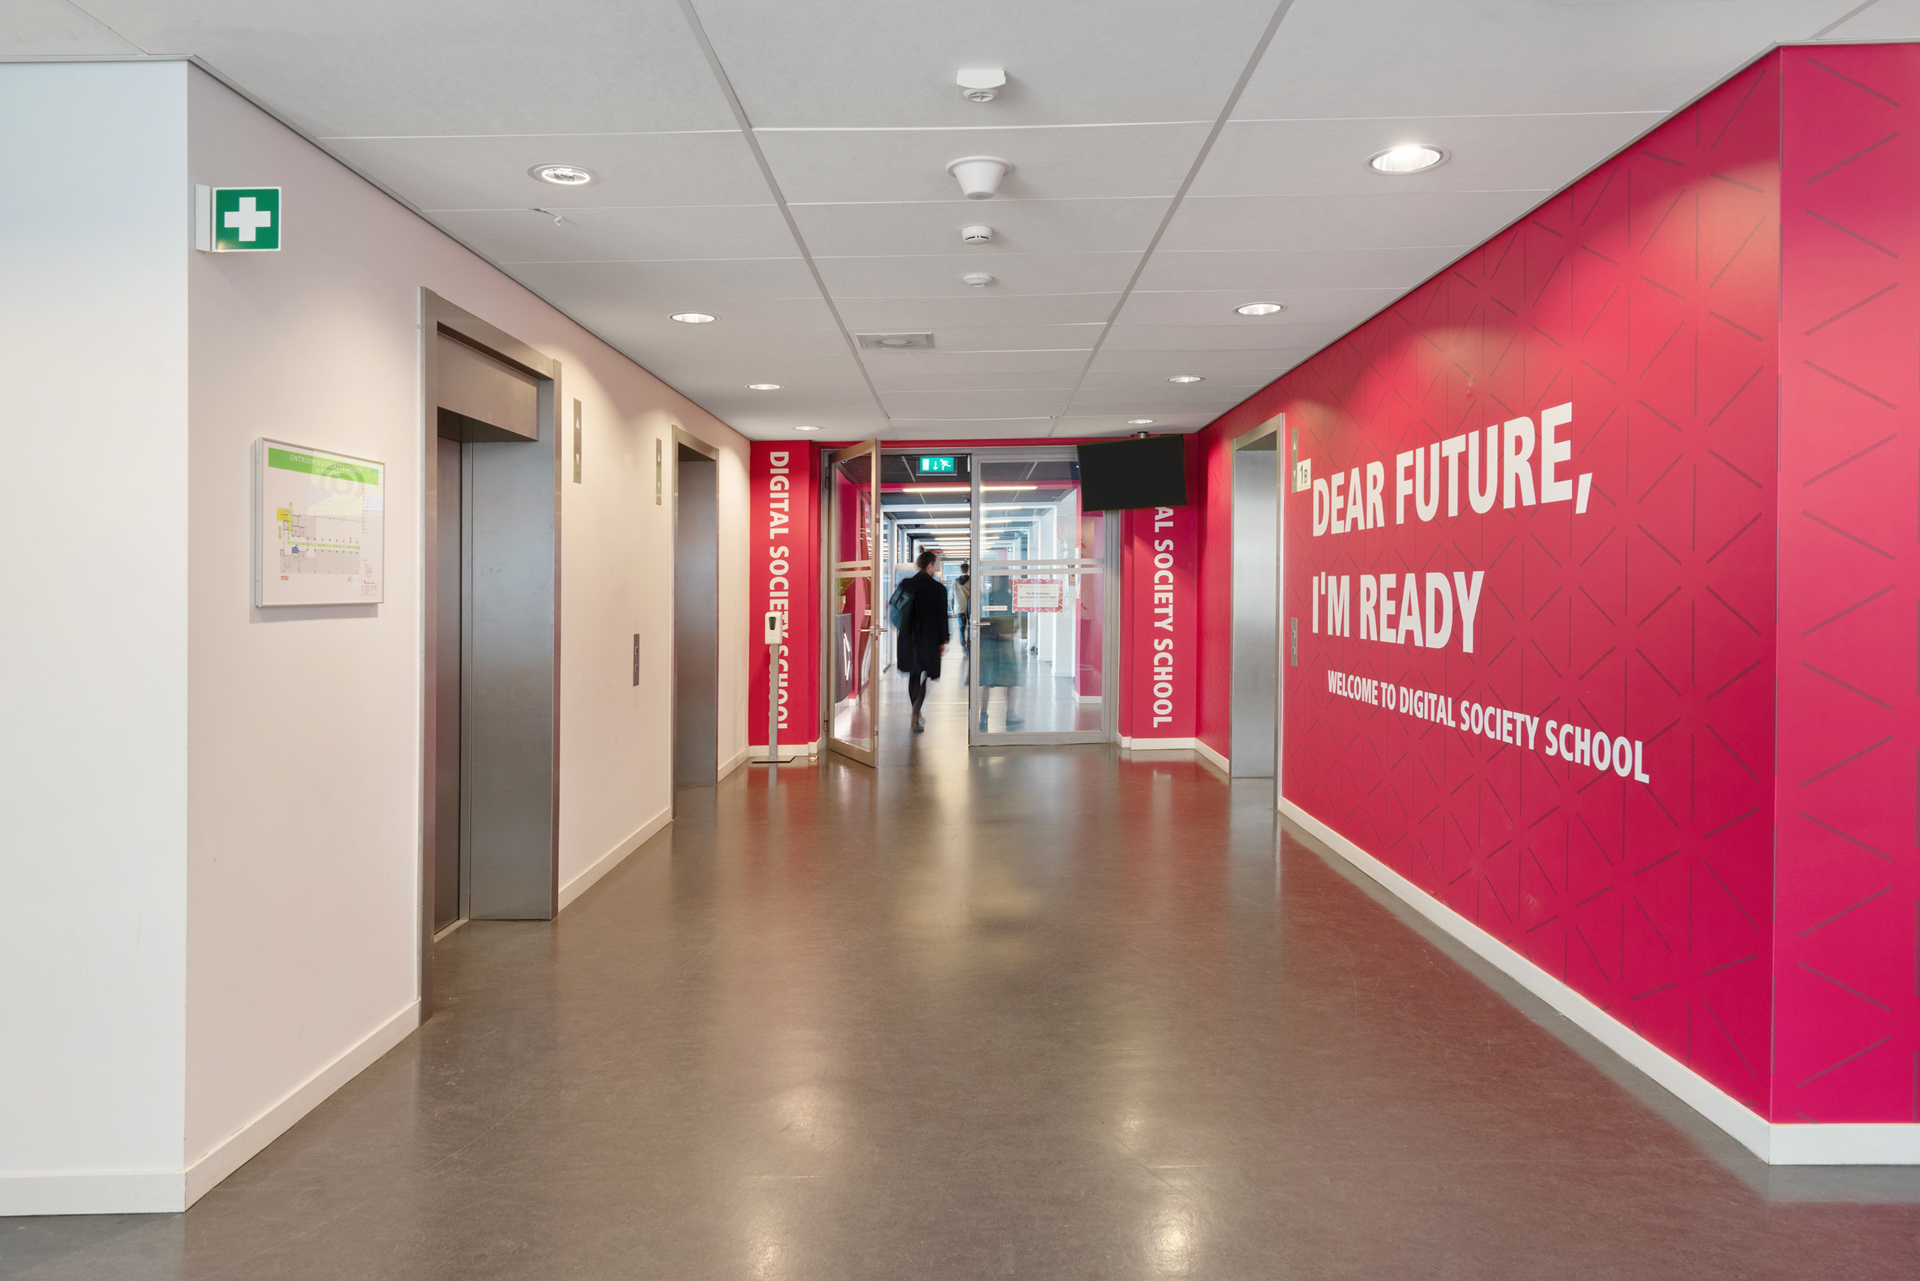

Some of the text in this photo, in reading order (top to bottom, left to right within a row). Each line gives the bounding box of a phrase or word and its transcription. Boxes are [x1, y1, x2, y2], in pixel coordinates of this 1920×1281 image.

[769, 451, 790, 540] DIGITAL
[1300, 464, 1308, 484] 1B
[1313, 402, 1593, 537] DEAR FUTURE,
[1153, 539, 1174, 632] SOCIETY
[1312, 571, 1485, 653] I'M READY
[1153, 638, 1174, 728] SCHOOL
[1327, 670, 1650, 784] WELCOME TO DIGITAL SOCIETY SCHOOL
